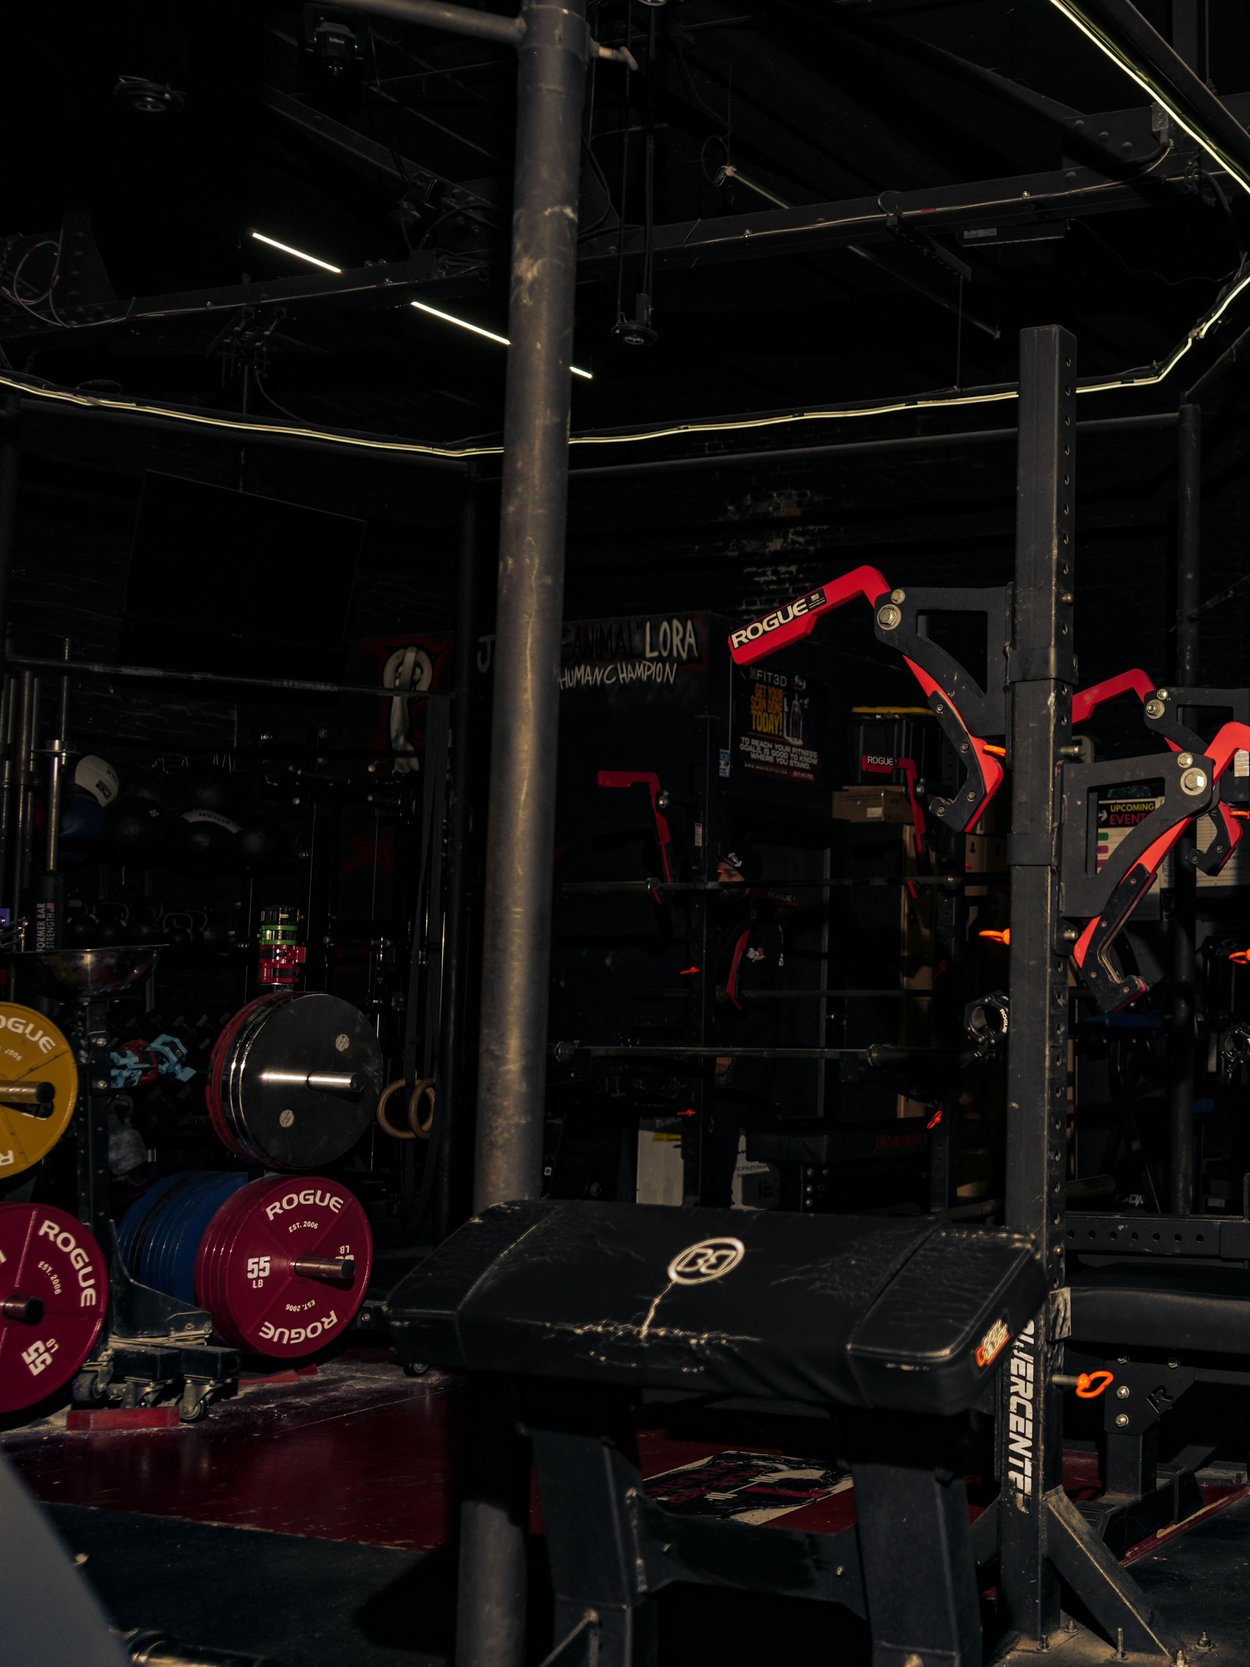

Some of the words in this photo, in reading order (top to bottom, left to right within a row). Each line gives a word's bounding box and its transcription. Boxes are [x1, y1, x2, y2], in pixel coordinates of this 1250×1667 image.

[731, 599, 808, 649] ROGUE
[645, 618, 698, 660] LORA
[751, 711, 783, 736] TODAY!
[867, 755, 894, 766] ROGUE
[1109, 813, 1149, 826] EVENT
[1110, 803, 1155, 813] UPCOMING
[46, 912, 56, 950] STRENGTH
[265, 1189, 345, 1222] ROGUE
[303, 1220, 319, 1230] 2006
[38, 1219, 97, 1308] ROGUE
[247, 1256, 271, 1279] 55
[252, 1279, 264, 1289] LB
[258, 1310, 339, 1345] ROGUE
[46, 1337, 60, 1354] LB
[20, 1340, 54, 1377] 55
